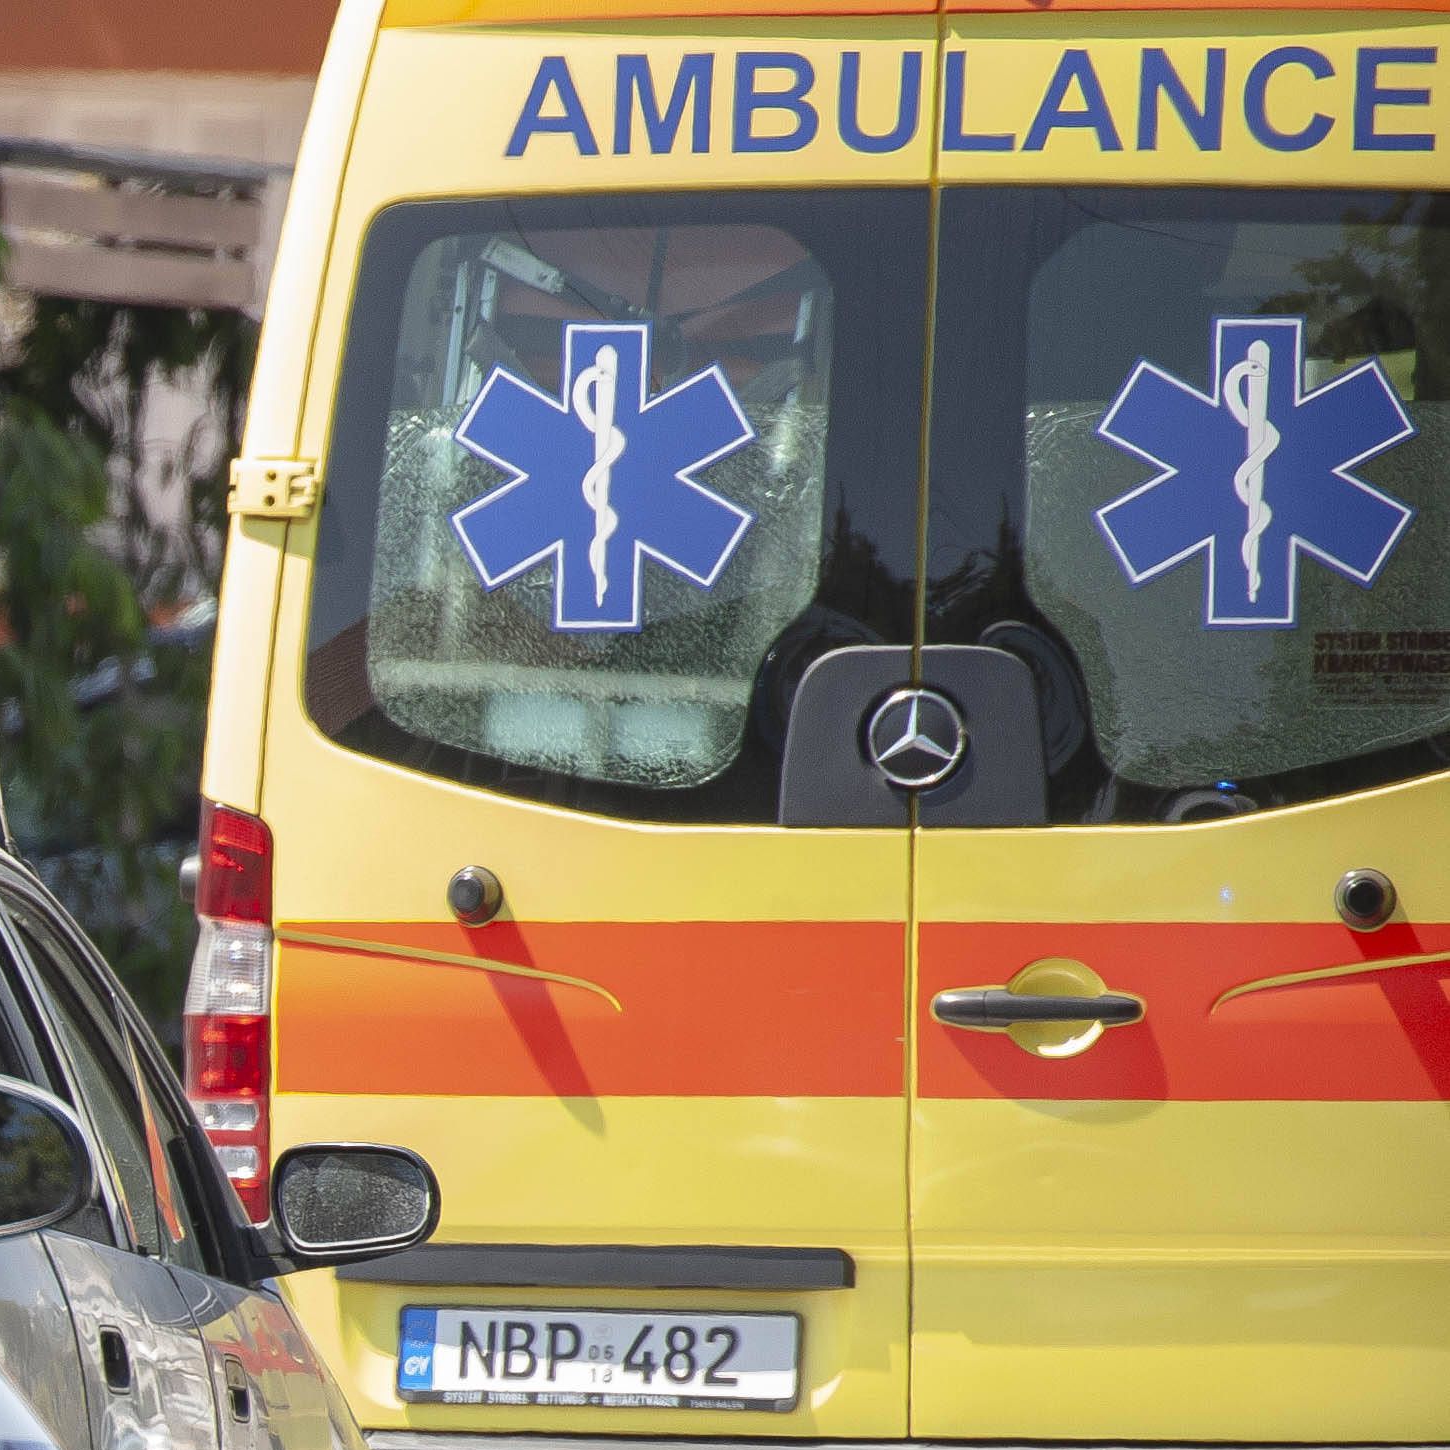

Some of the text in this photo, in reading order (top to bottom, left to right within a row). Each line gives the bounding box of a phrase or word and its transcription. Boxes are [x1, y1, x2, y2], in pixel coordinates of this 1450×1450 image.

[504, 46, 1438, 157] AMBULANCE
[458, 1320, 740, 1388] NBP 482
